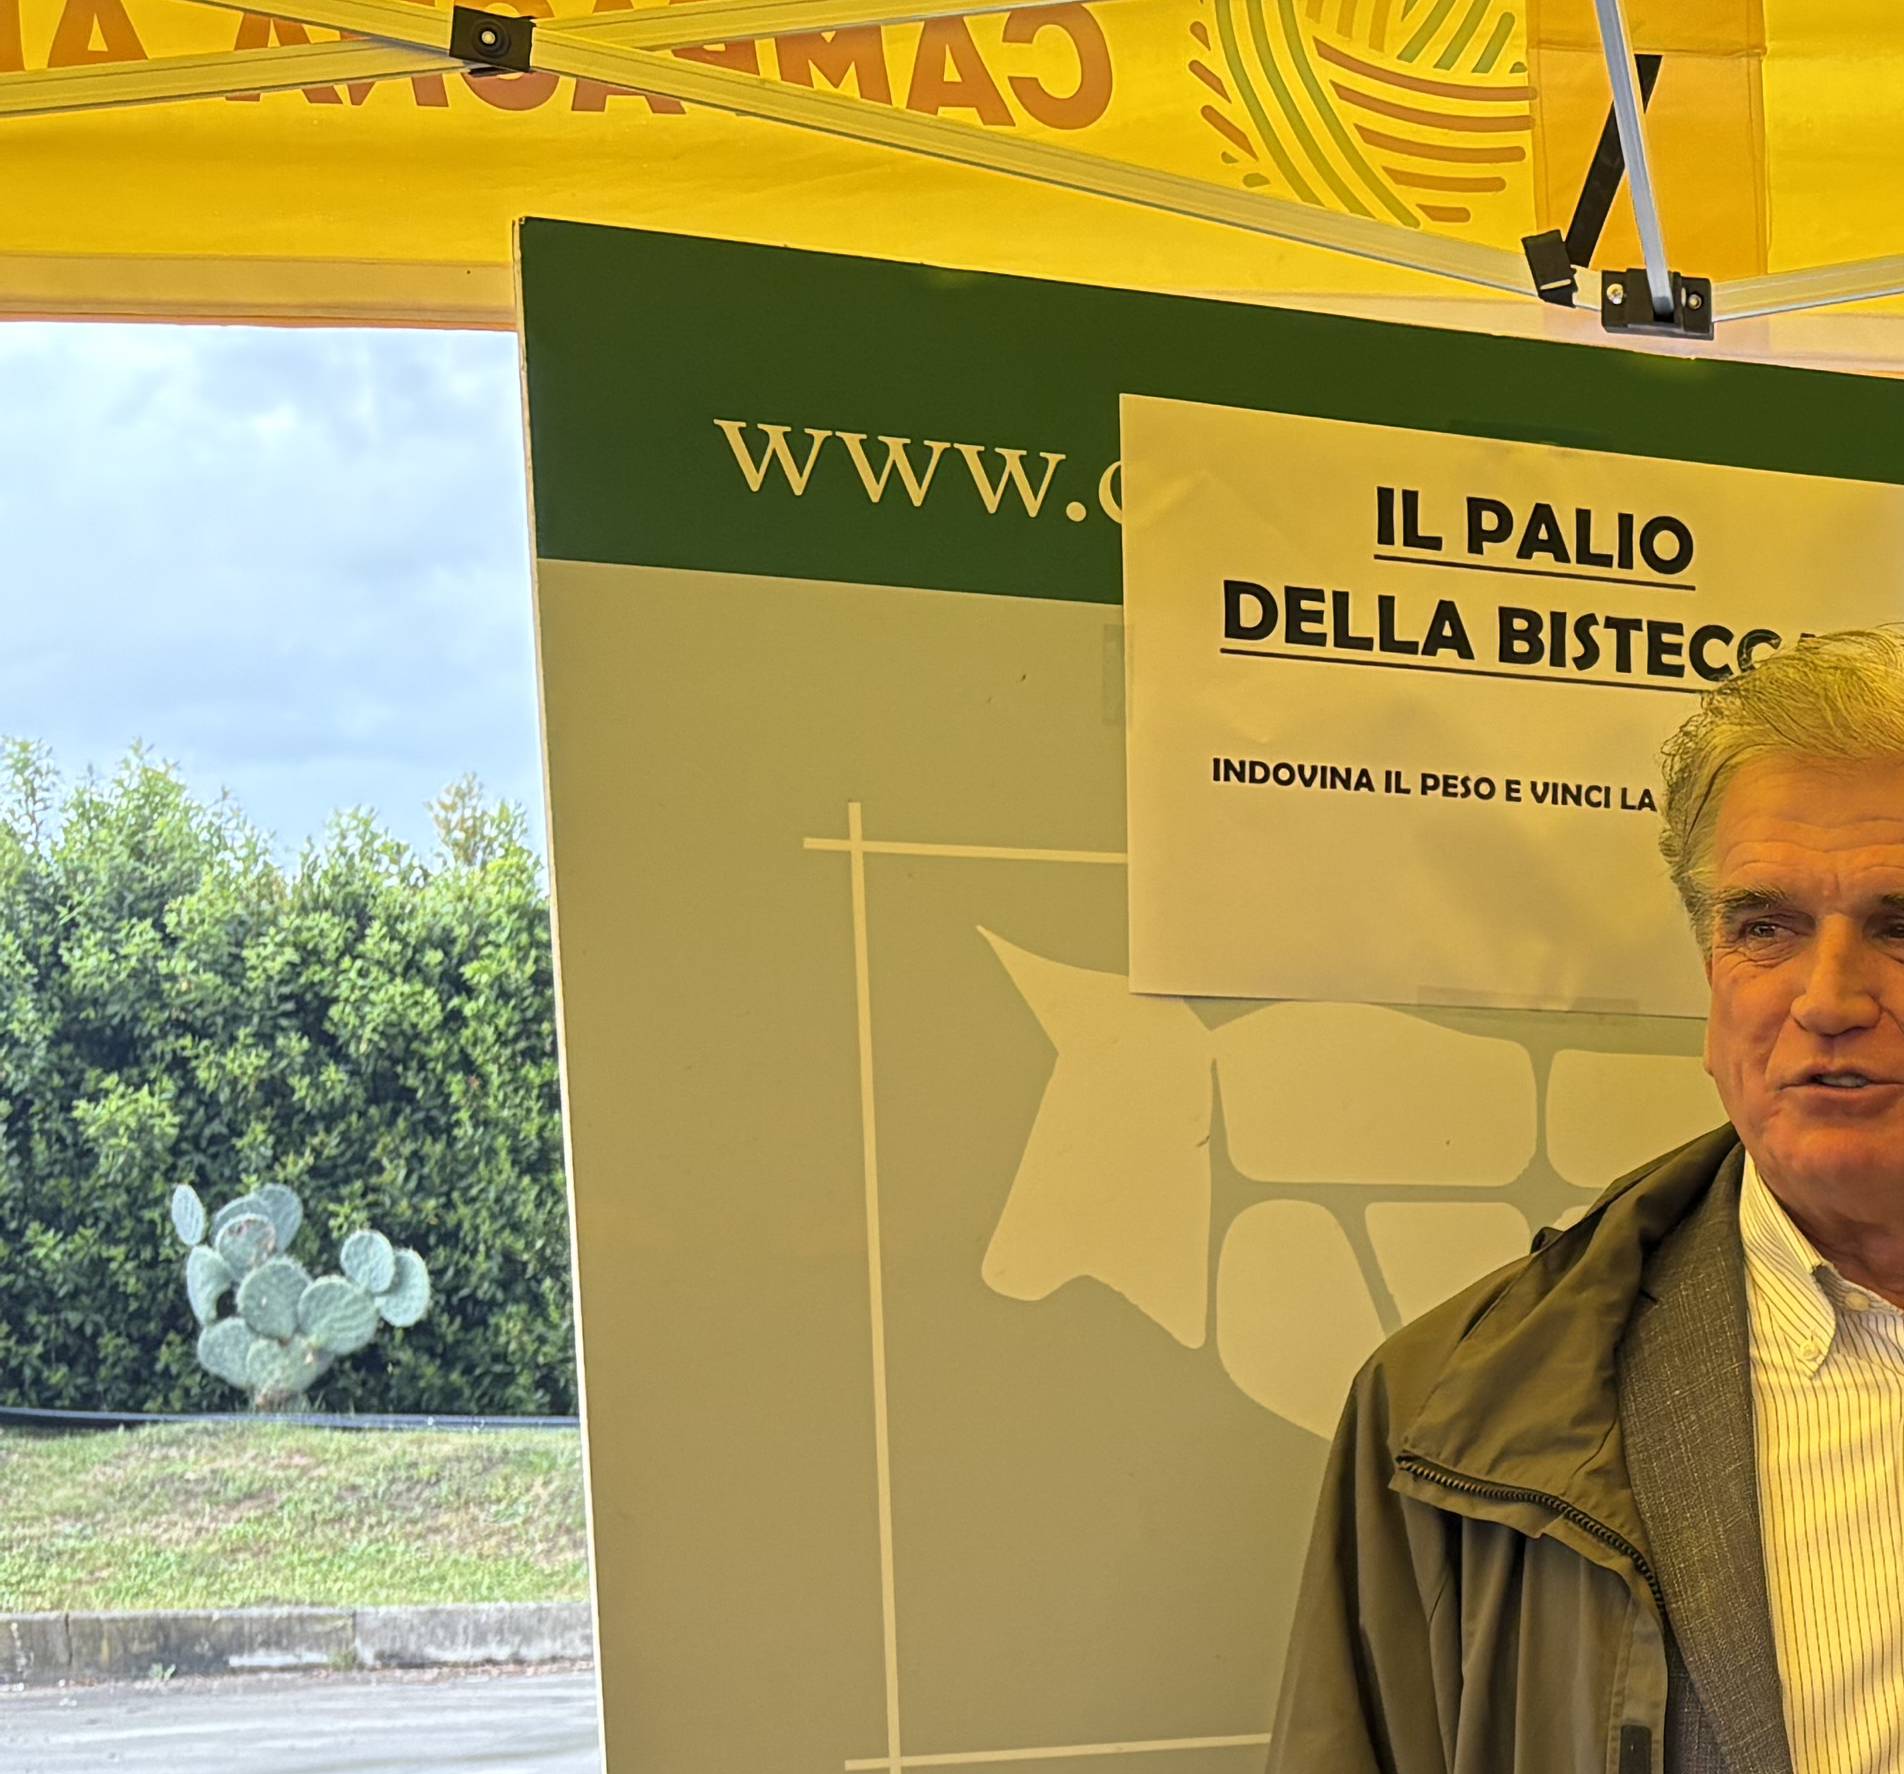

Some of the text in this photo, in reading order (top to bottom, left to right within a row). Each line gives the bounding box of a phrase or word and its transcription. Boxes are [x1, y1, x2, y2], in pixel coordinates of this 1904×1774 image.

[1375, 485, 1694, 576] IL PALIO
[1222, 578, 1816, 683] DELLA BISTECC
[1211, 757, 1658, 813] INDOVINA IL PESO E VINCI LA
